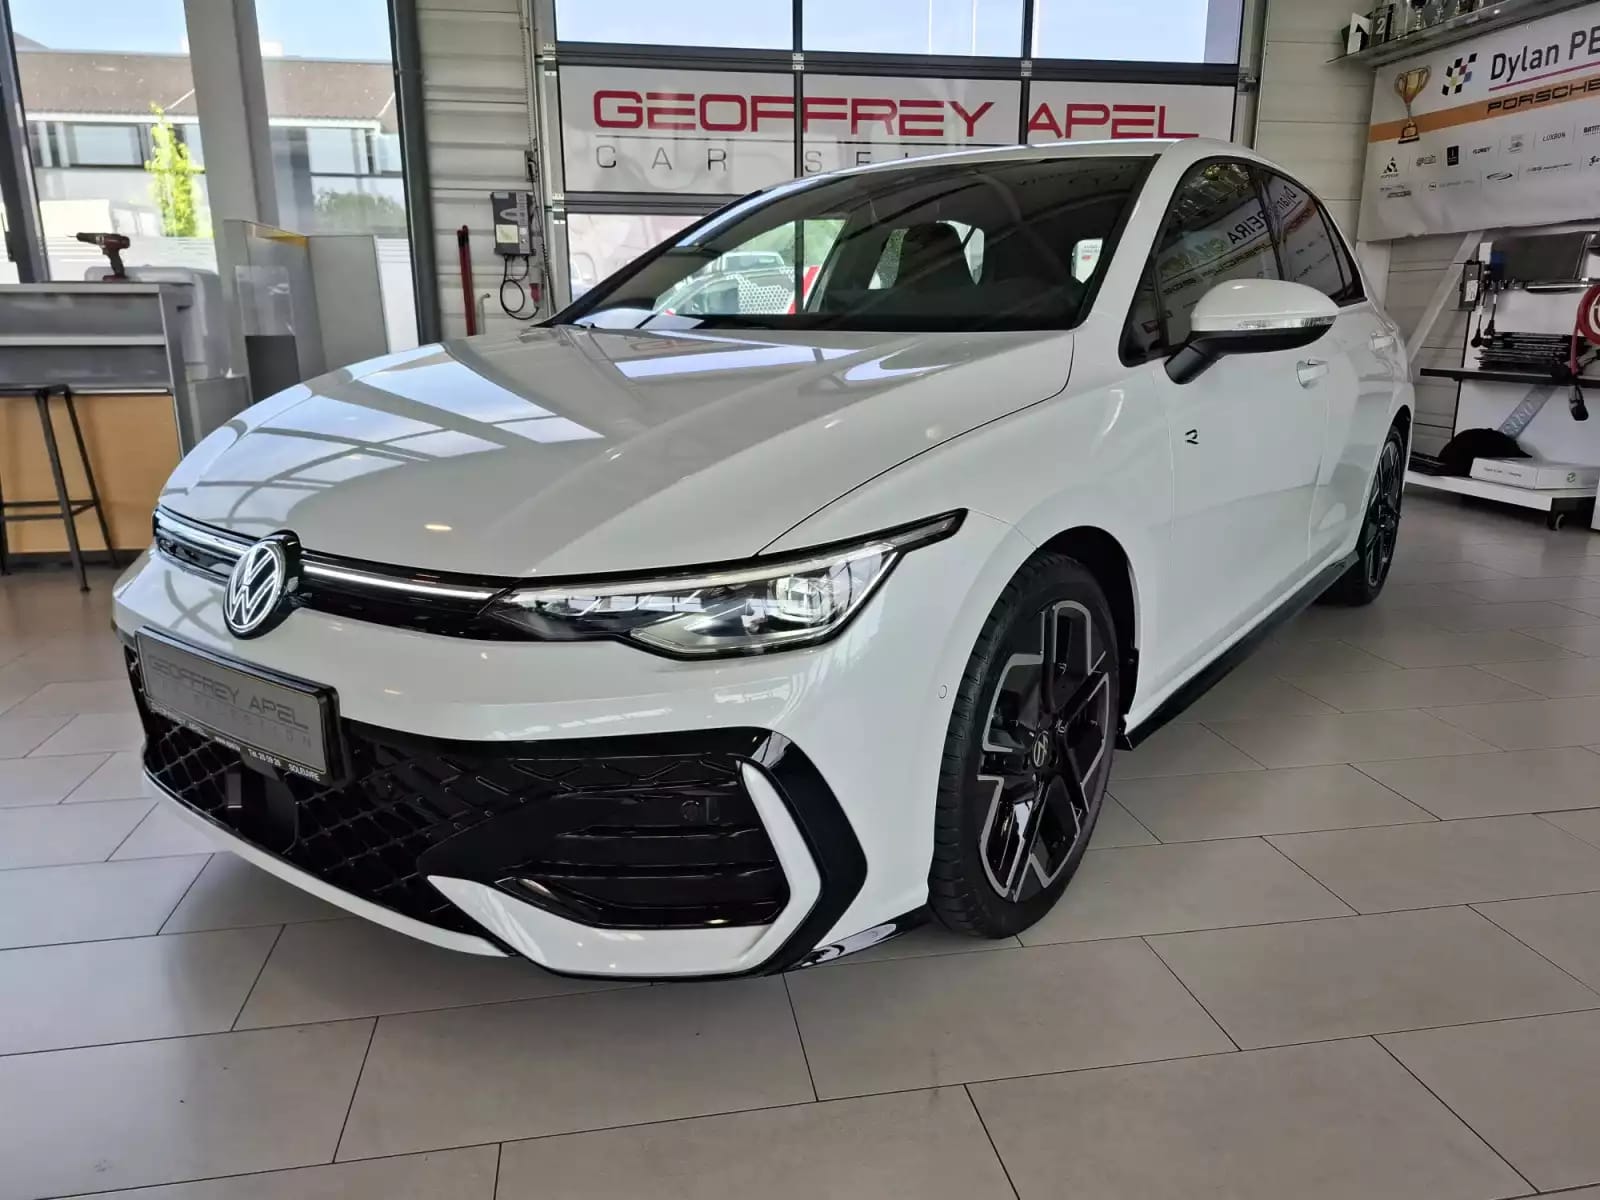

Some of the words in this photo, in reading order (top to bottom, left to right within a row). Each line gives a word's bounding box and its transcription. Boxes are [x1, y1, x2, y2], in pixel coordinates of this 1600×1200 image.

[1490, 44, 1560, 83] Dylan
[593, 90, 995, 137] GEOFFREY
[1027, 102, 1200, 139] APEL
[1487, 78, 1600, 114] PORSCHE
